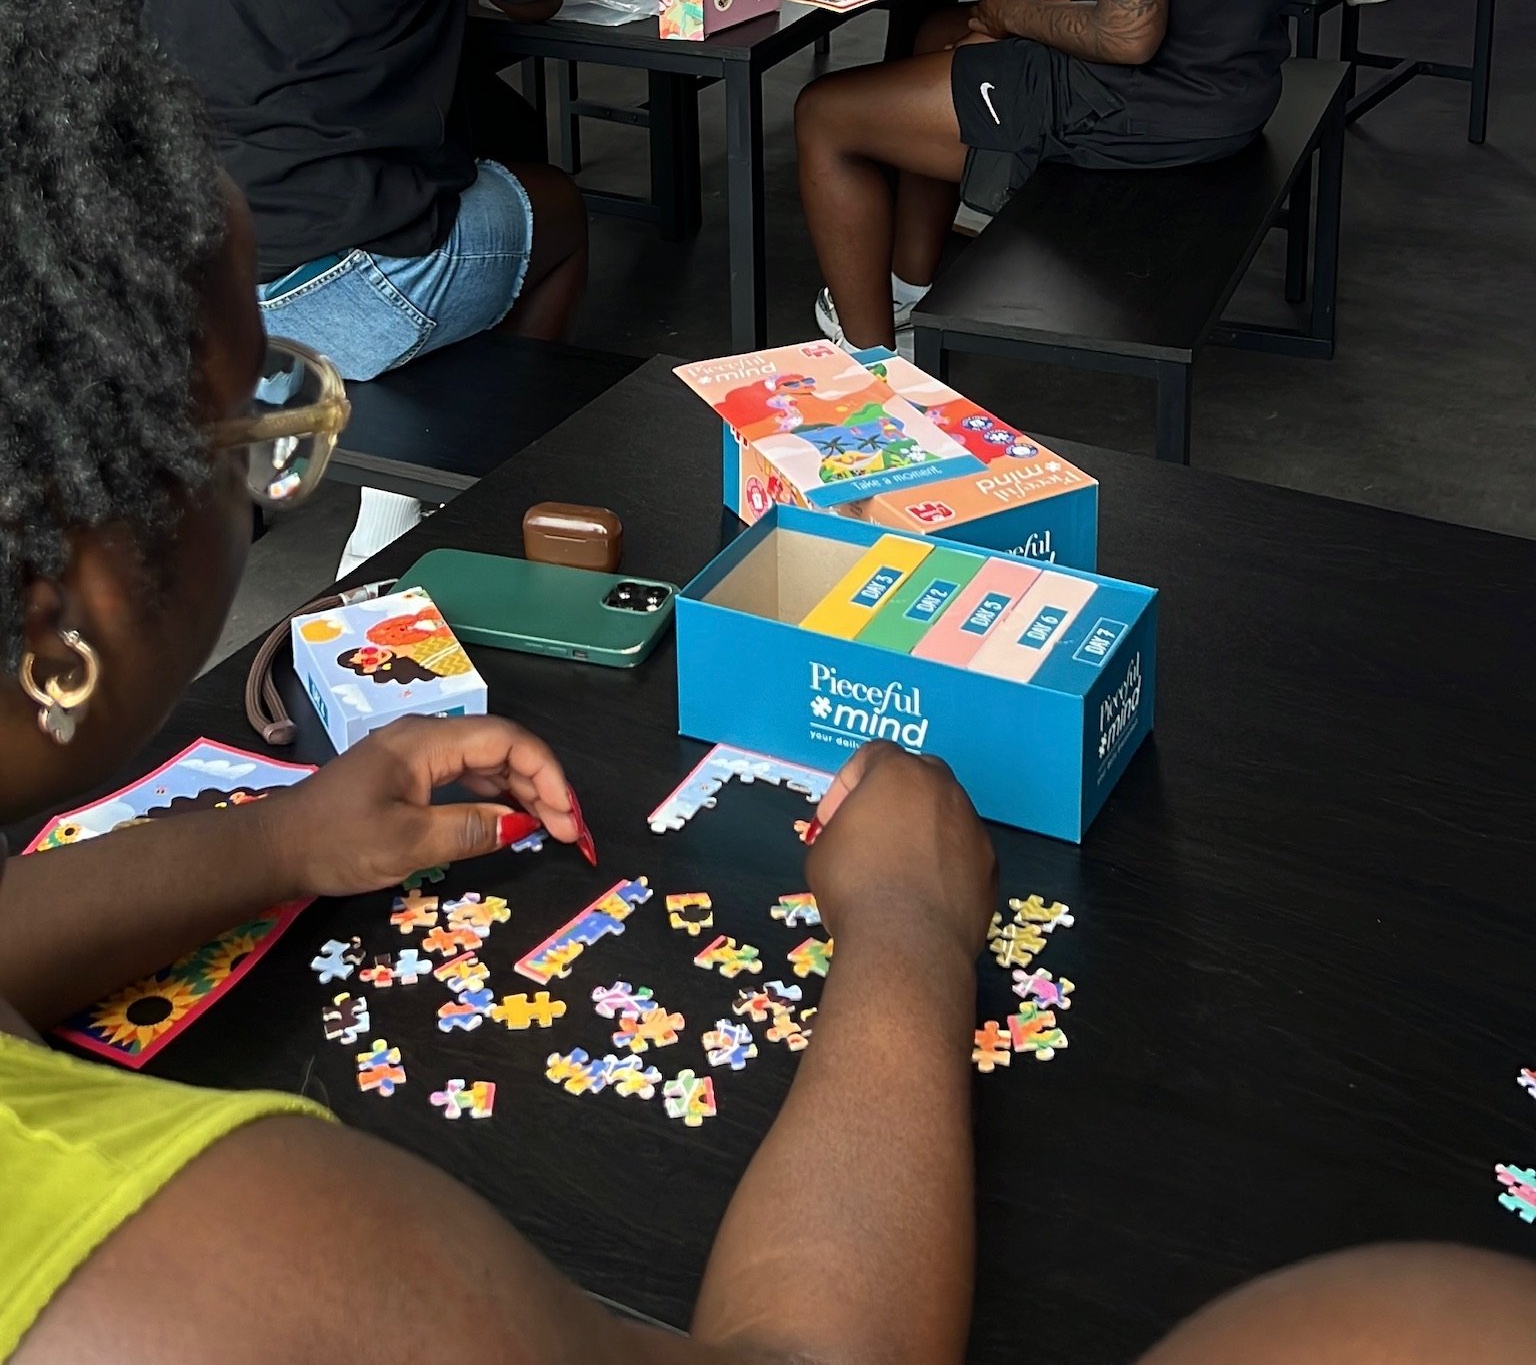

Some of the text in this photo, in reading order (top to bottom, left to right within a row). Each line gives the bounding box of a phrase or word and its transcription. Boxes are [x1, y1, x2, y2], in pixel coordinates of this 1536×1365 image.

[687, 354, 766, 378] Pieceful
[716, 362, 776, 383] mind
[850, 479, 882, 491] Take
[883, 476, 892, 485] a
[976, 463, 1044, 495] mind
[993, 471, 1082, 503] Pieceful
[861, 574, 894, 600] DAY 3
[916, 588, 948, 613] DAY 2
[970, 600, 1003, 628] DAY 5
[1027, 614, 1059, 641] DAY 6
[1084, 627, 1116, 656] DAY 7
[808, 661, 922, 718] Pieceful
[1100, 650, 1141, 733] Pieceful
[833, 703, 929, 748] mind
[1106, 674, 1142, 752] mind
[809, 730, 833, 743] your
